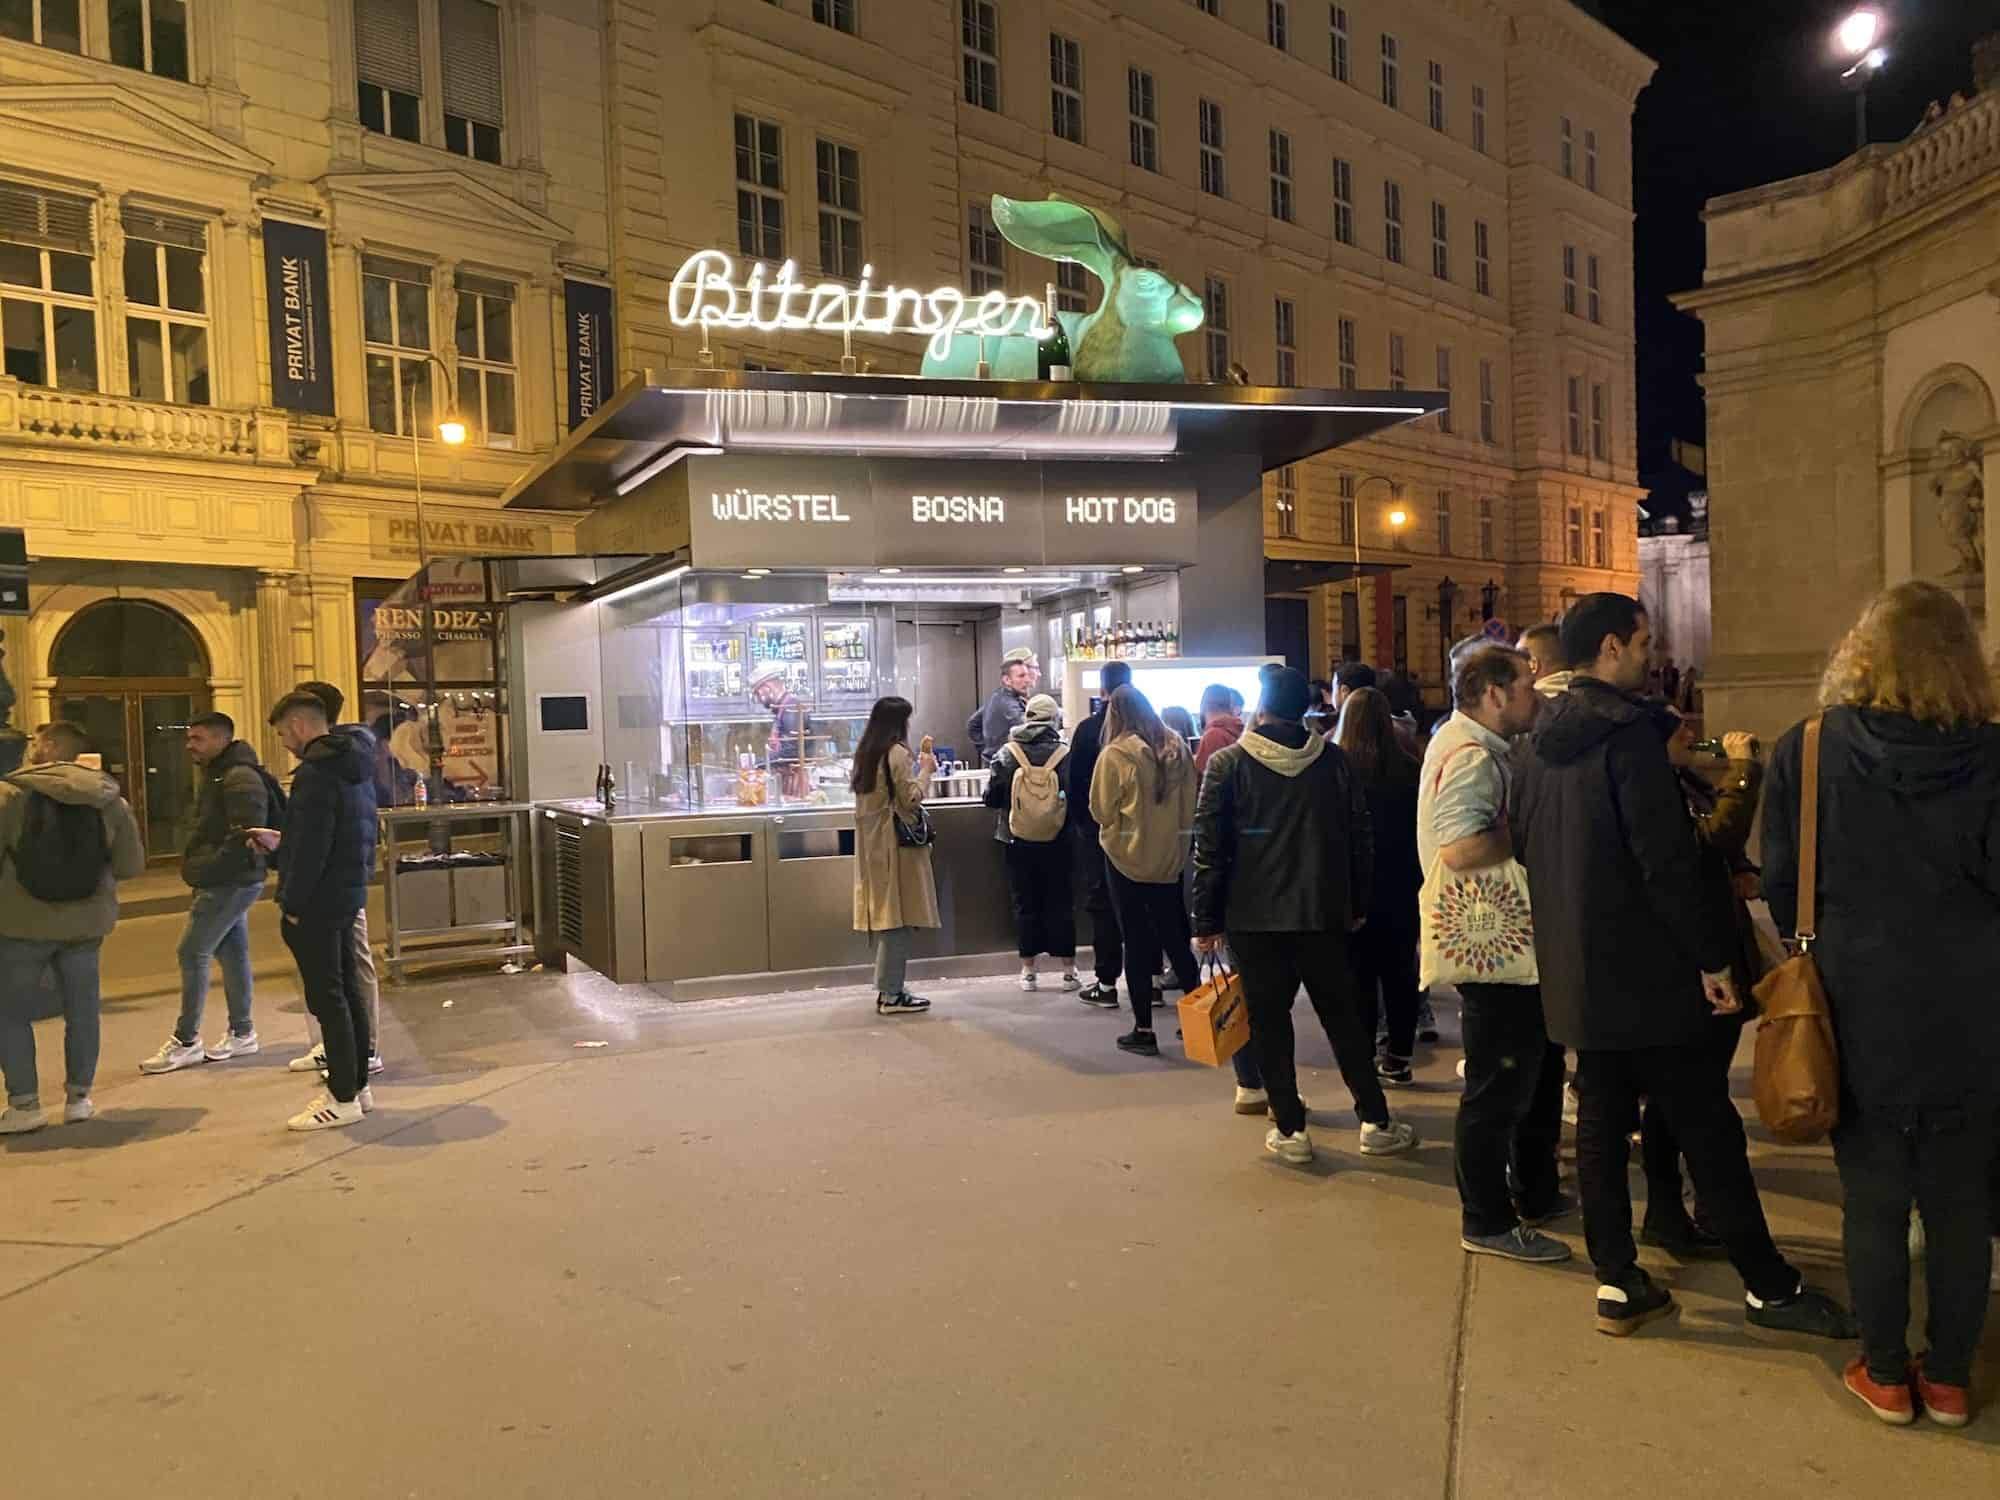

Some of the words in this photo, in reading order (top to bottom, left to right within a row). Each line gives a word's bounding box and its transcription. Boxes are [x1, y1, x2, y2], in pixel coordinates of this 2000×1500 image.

[284, 255, 302, 310] BANK
[668, 249, 1055, 361] Bitzinger
[288, 314, 305, 381] PRIVAT
[578, 312, 592, 358] BANK
[580, 360, 594, 418] PRIVAT
[388, 519, 466, 543] PRVAT
[474, 524, 536, 547] BANK
[711, 490, 851, 524] WÜRSTEL
[911, 495, 1005, 524] BOSNA
[1065, 497, 1119, 524] HOT
[1123, 497, 1177, 525] DOG
